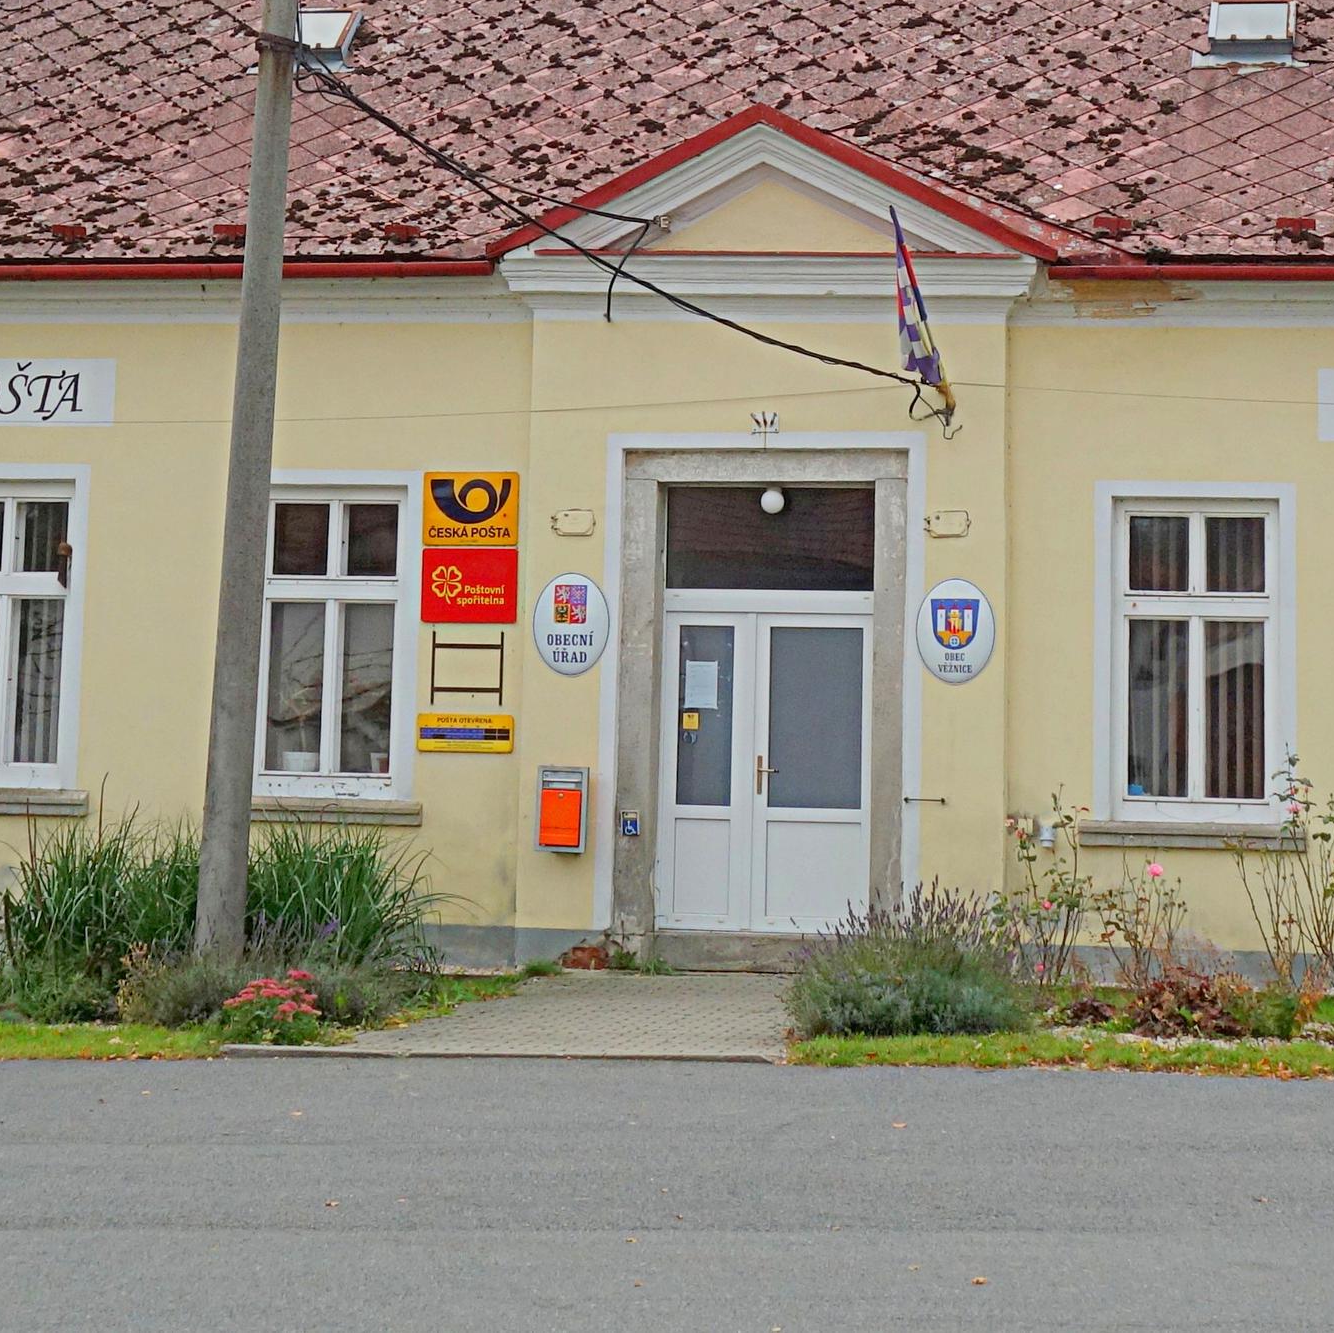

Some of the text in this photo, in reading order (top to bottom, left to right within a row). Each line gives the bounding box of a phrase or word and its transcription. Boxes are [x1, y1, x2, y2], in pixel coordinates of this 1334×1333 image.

[428, 525, 511, 538] ČESKÁ POŠTA
[464, 584, 505, 595] Poštovní
[456, 595, 505, 607] spořitelna
[547, 630, 594, 646] OBECNÍ
[552, 647, 587, 663] ÚŘAD
[944, 652, 966, 662] OBEC
[436, 715, 457, 724] POŠTA
